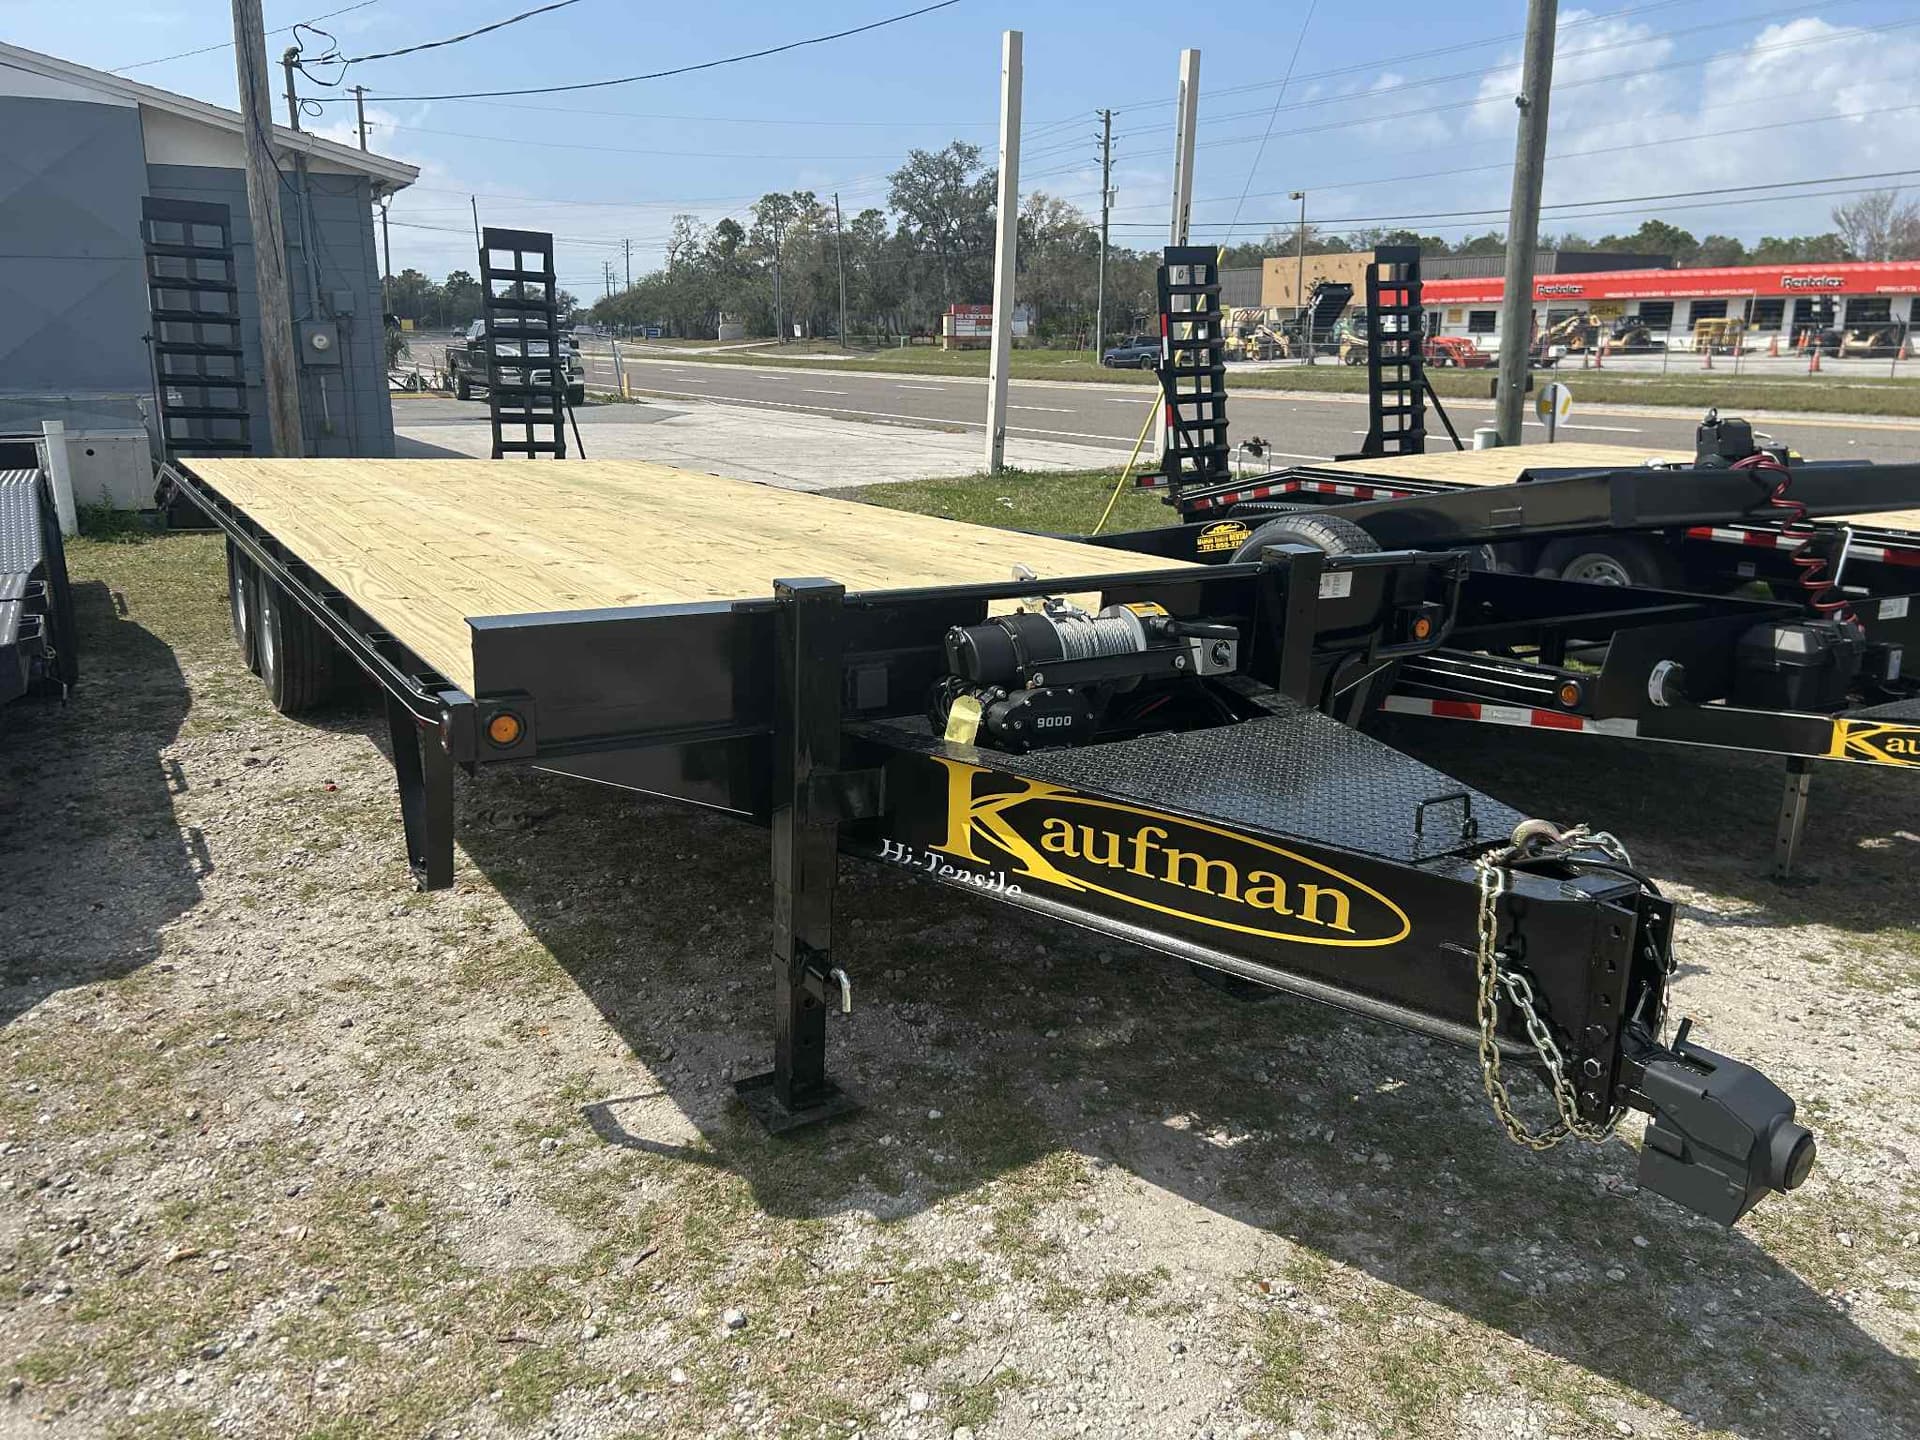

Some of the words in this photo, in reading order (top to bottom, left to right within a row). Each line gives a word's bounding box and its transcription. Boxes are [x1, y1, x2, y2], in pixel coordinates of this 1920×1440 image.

[1781, 275, 1845, 289] Rentalex
[1537, 283, 1583, 298] Rentalex
[1037, 715, 1072, 728] 9000
[929, 756, 1356, 934] Kaufman
[877, 838, 1022, 898] Hi-Tensile
